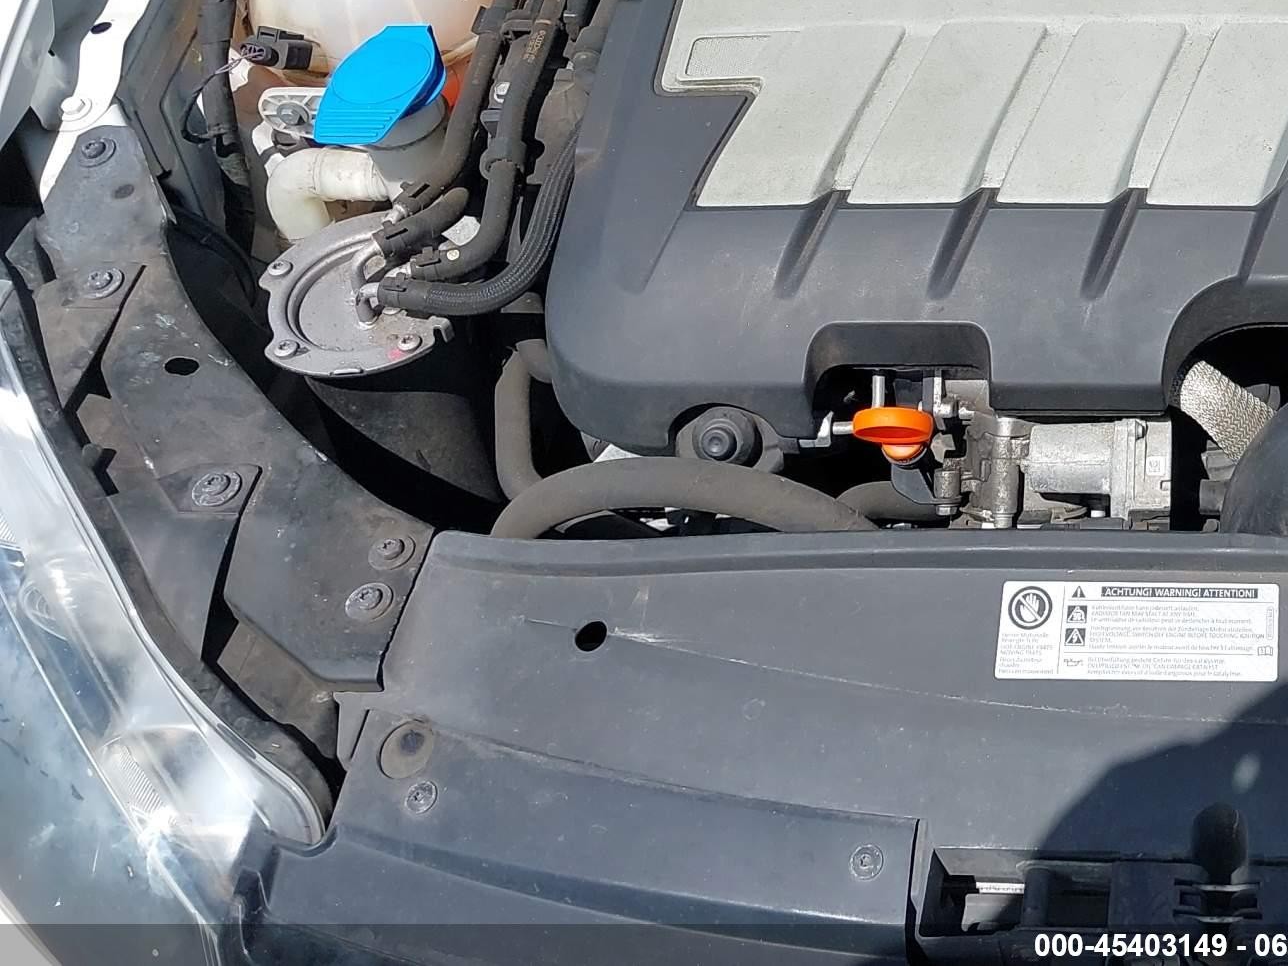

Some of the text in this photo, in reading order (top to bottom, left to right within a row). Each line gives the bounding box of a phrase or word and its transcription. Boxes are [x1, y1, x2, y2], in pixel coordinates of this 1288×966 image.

[1105, 587, 1256, 599] ACHTUNG! WARNING! ATTENTION!
